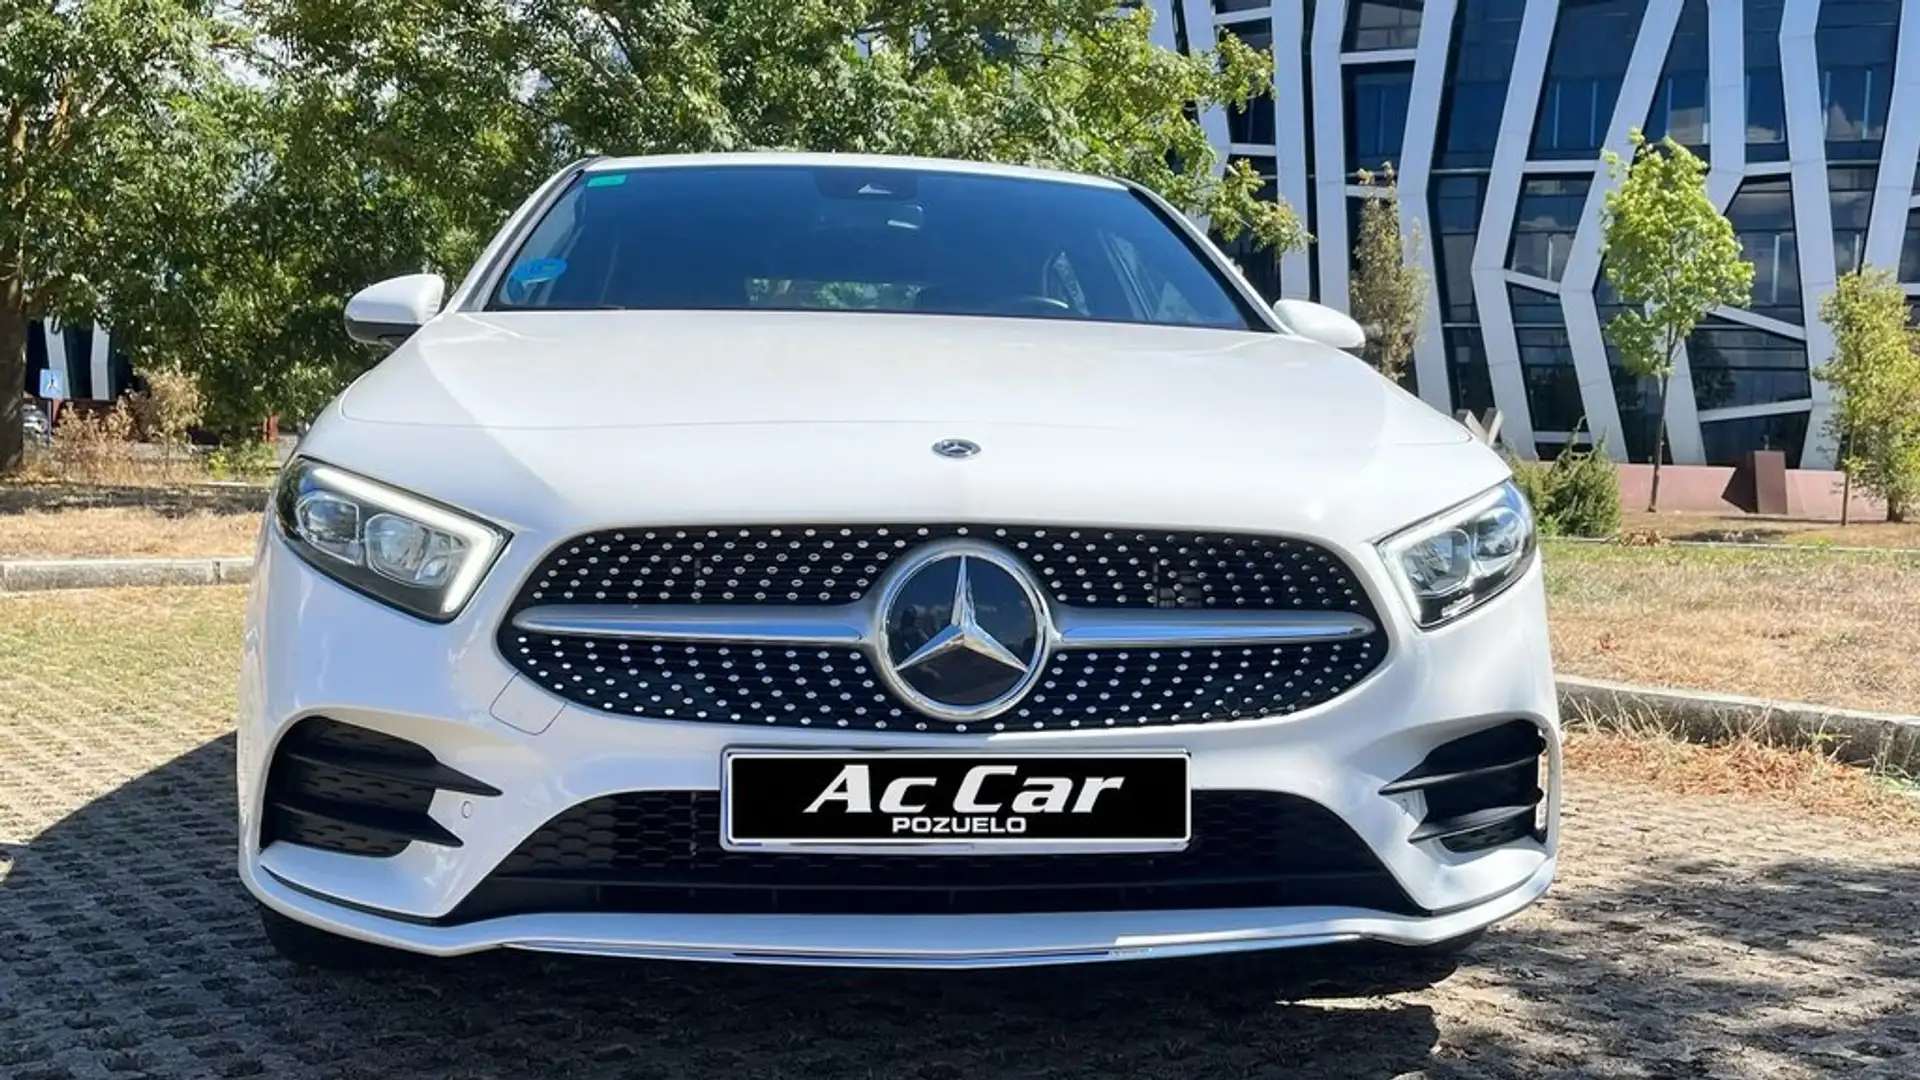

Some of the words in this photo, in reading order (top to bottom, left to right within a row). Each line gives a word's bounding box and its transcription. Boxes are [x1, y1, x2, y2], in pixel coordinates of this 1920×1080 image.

[803, 764, 938, 813] Ac
[953, 765, 1125, 814] Car
[892, 817, 1027, 833] POZUELO
